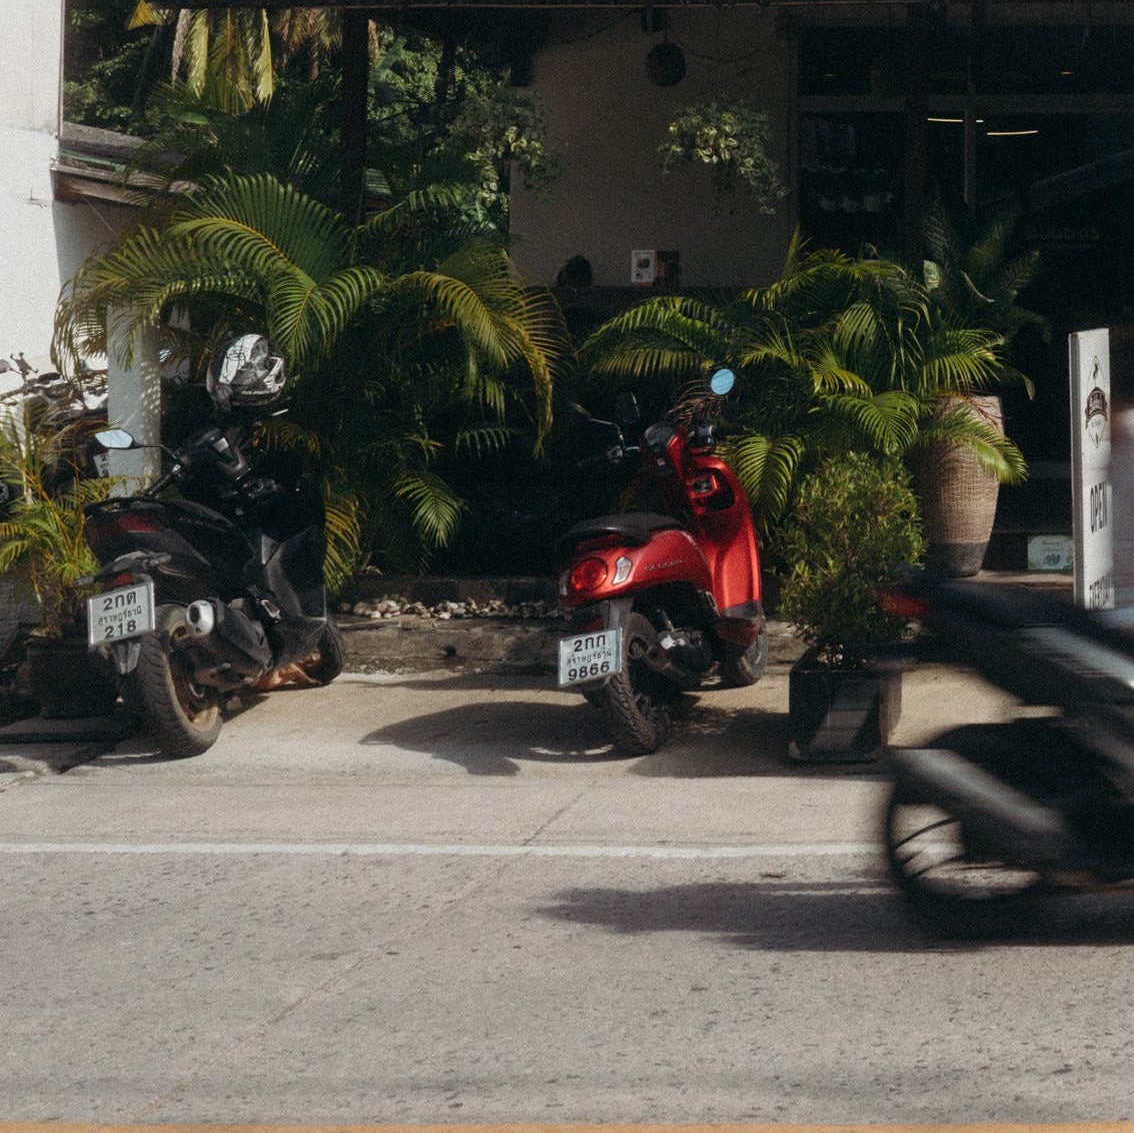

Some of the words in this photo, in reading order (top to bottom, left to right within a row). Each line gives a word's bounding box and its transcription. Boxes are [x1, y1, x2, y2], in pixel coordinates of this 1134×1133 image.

[1090, 480, 1108, 534] OPEN
[104, 619, 137, 639] 218
[573, 634, 606, 652] 2กก
[568, 661, 610, 681] 9866
